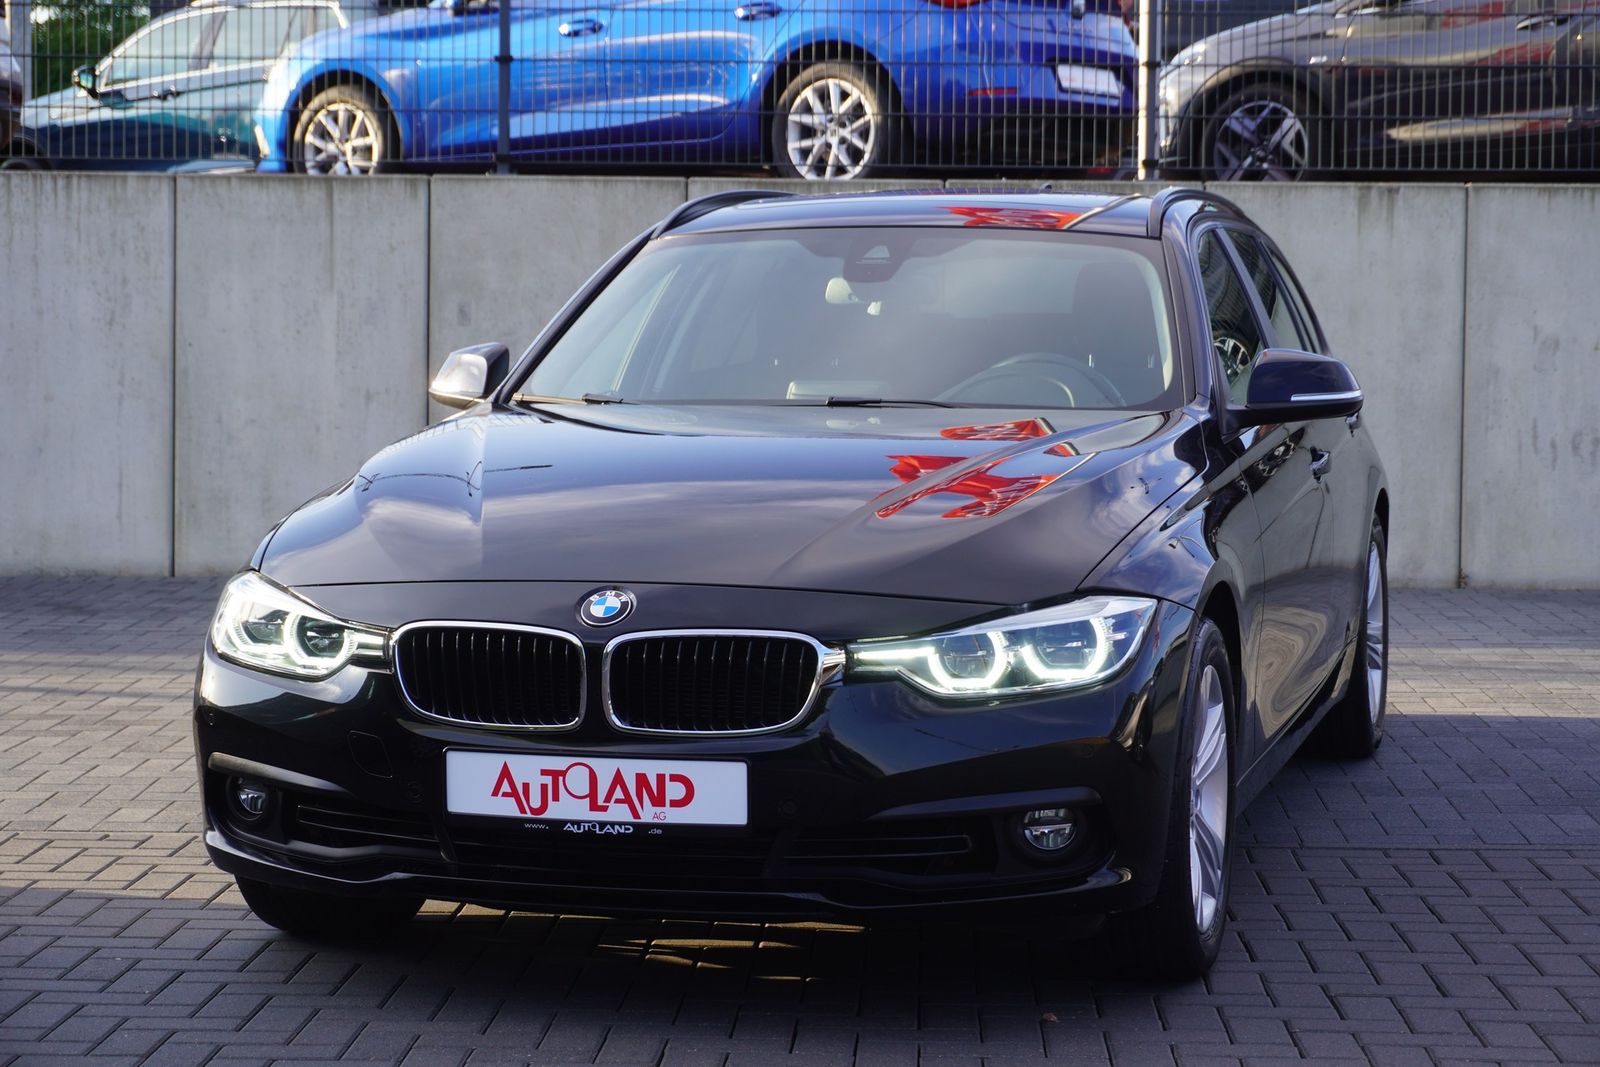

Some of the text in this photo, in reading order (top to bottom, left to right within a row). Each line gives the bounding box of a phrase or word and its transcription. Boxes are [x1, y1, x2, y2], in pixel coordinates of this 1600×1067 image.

[490, 760, 695, 820] AUTOLAND
[652, 811, 667, 821] AG
[524, 822, 662, 835] www. AUTOLAND .de
